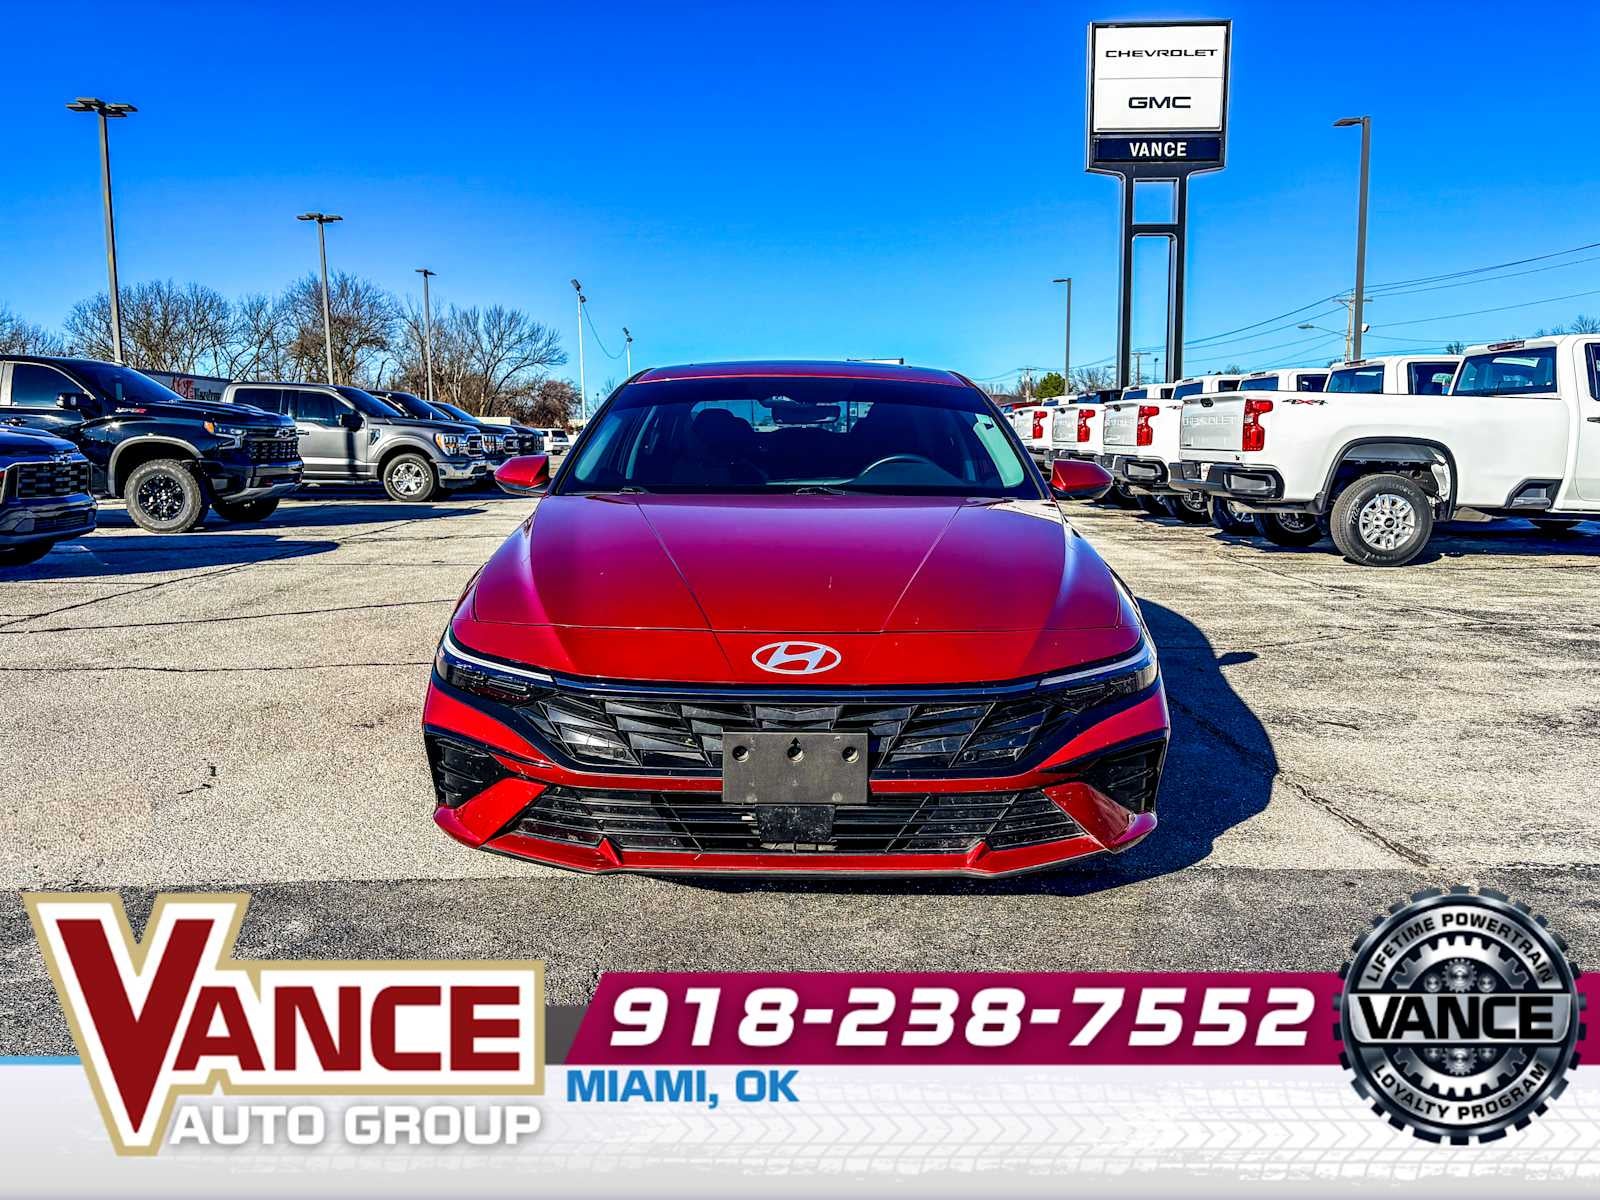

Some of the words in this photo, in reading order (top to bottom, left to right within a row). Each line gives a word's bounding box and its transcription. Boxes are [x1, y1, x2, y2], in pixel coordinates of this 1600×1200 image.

[1105, 48, 1218, 58] CHEVROLET
[1128, 96, 1191, 109] GMC
[1129, 142, 1187, 157] VANCE
